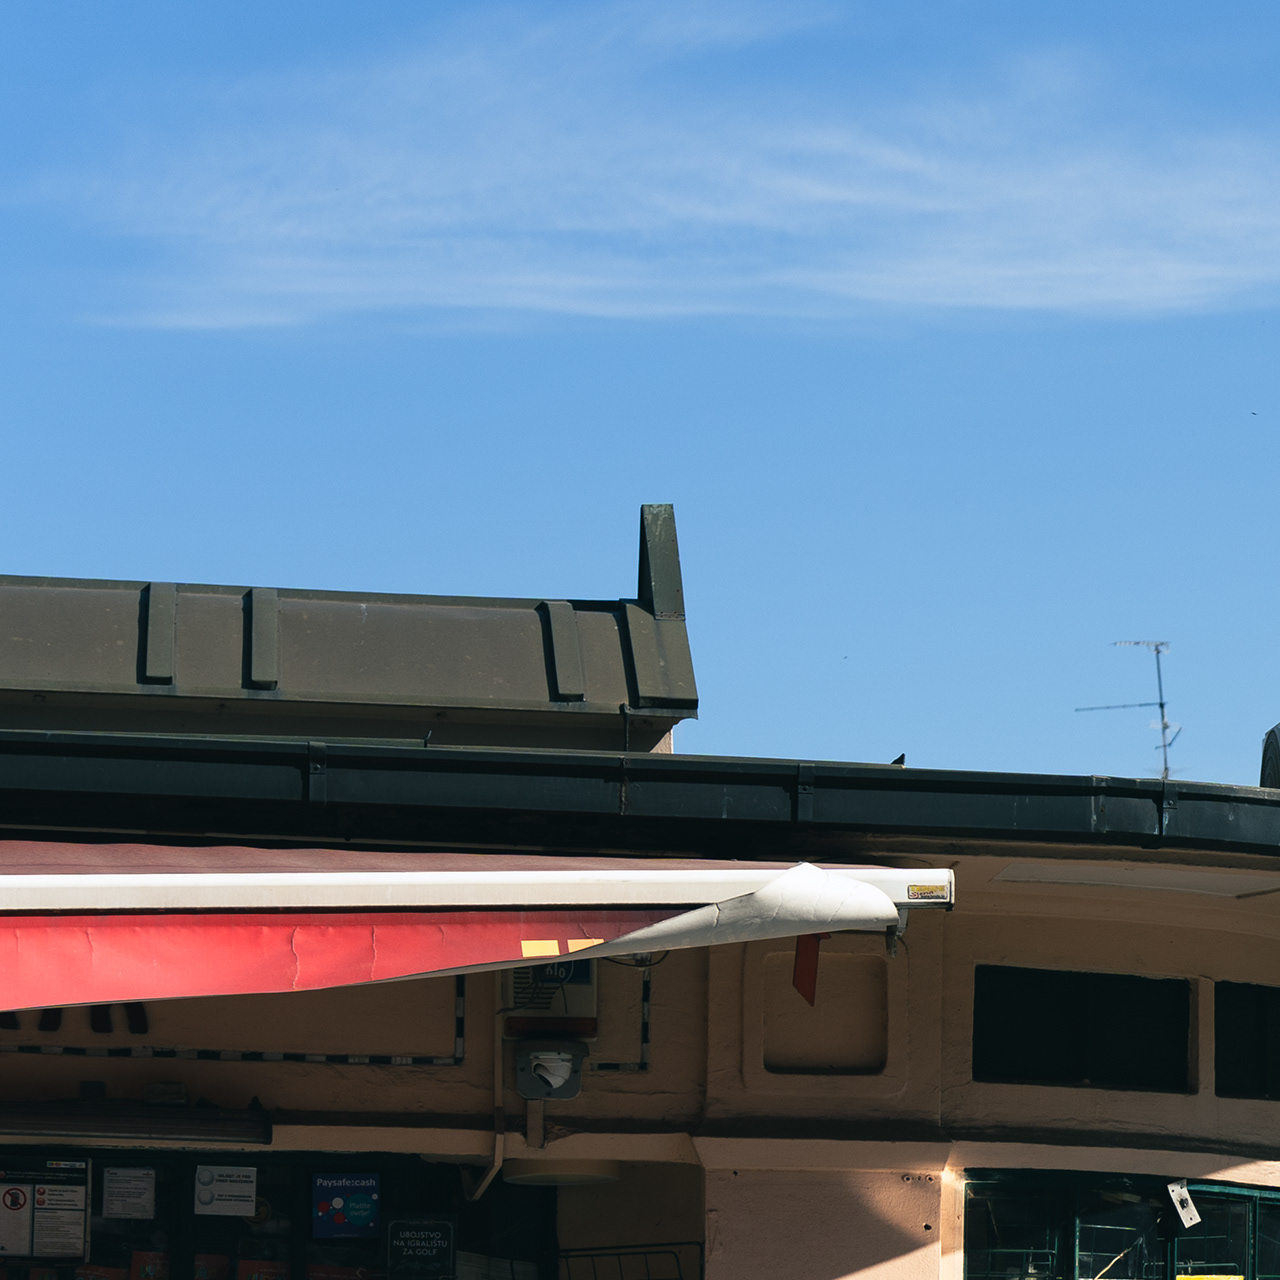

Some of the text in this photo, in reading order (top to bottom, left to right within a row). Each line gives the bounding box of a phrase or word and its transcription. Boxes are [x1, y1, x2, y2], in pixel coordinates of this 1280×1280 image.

[316, 1178, 376, 1188] Paysafe:cash
[349, 1202, 372, 1210] Platite
[399, 1230, 442, 1240] UBOJSTVO
[393, 1238, 448, 1248] NA IGRALIŠTU
[402, 1248, 438, 1256] ZA GOLF
